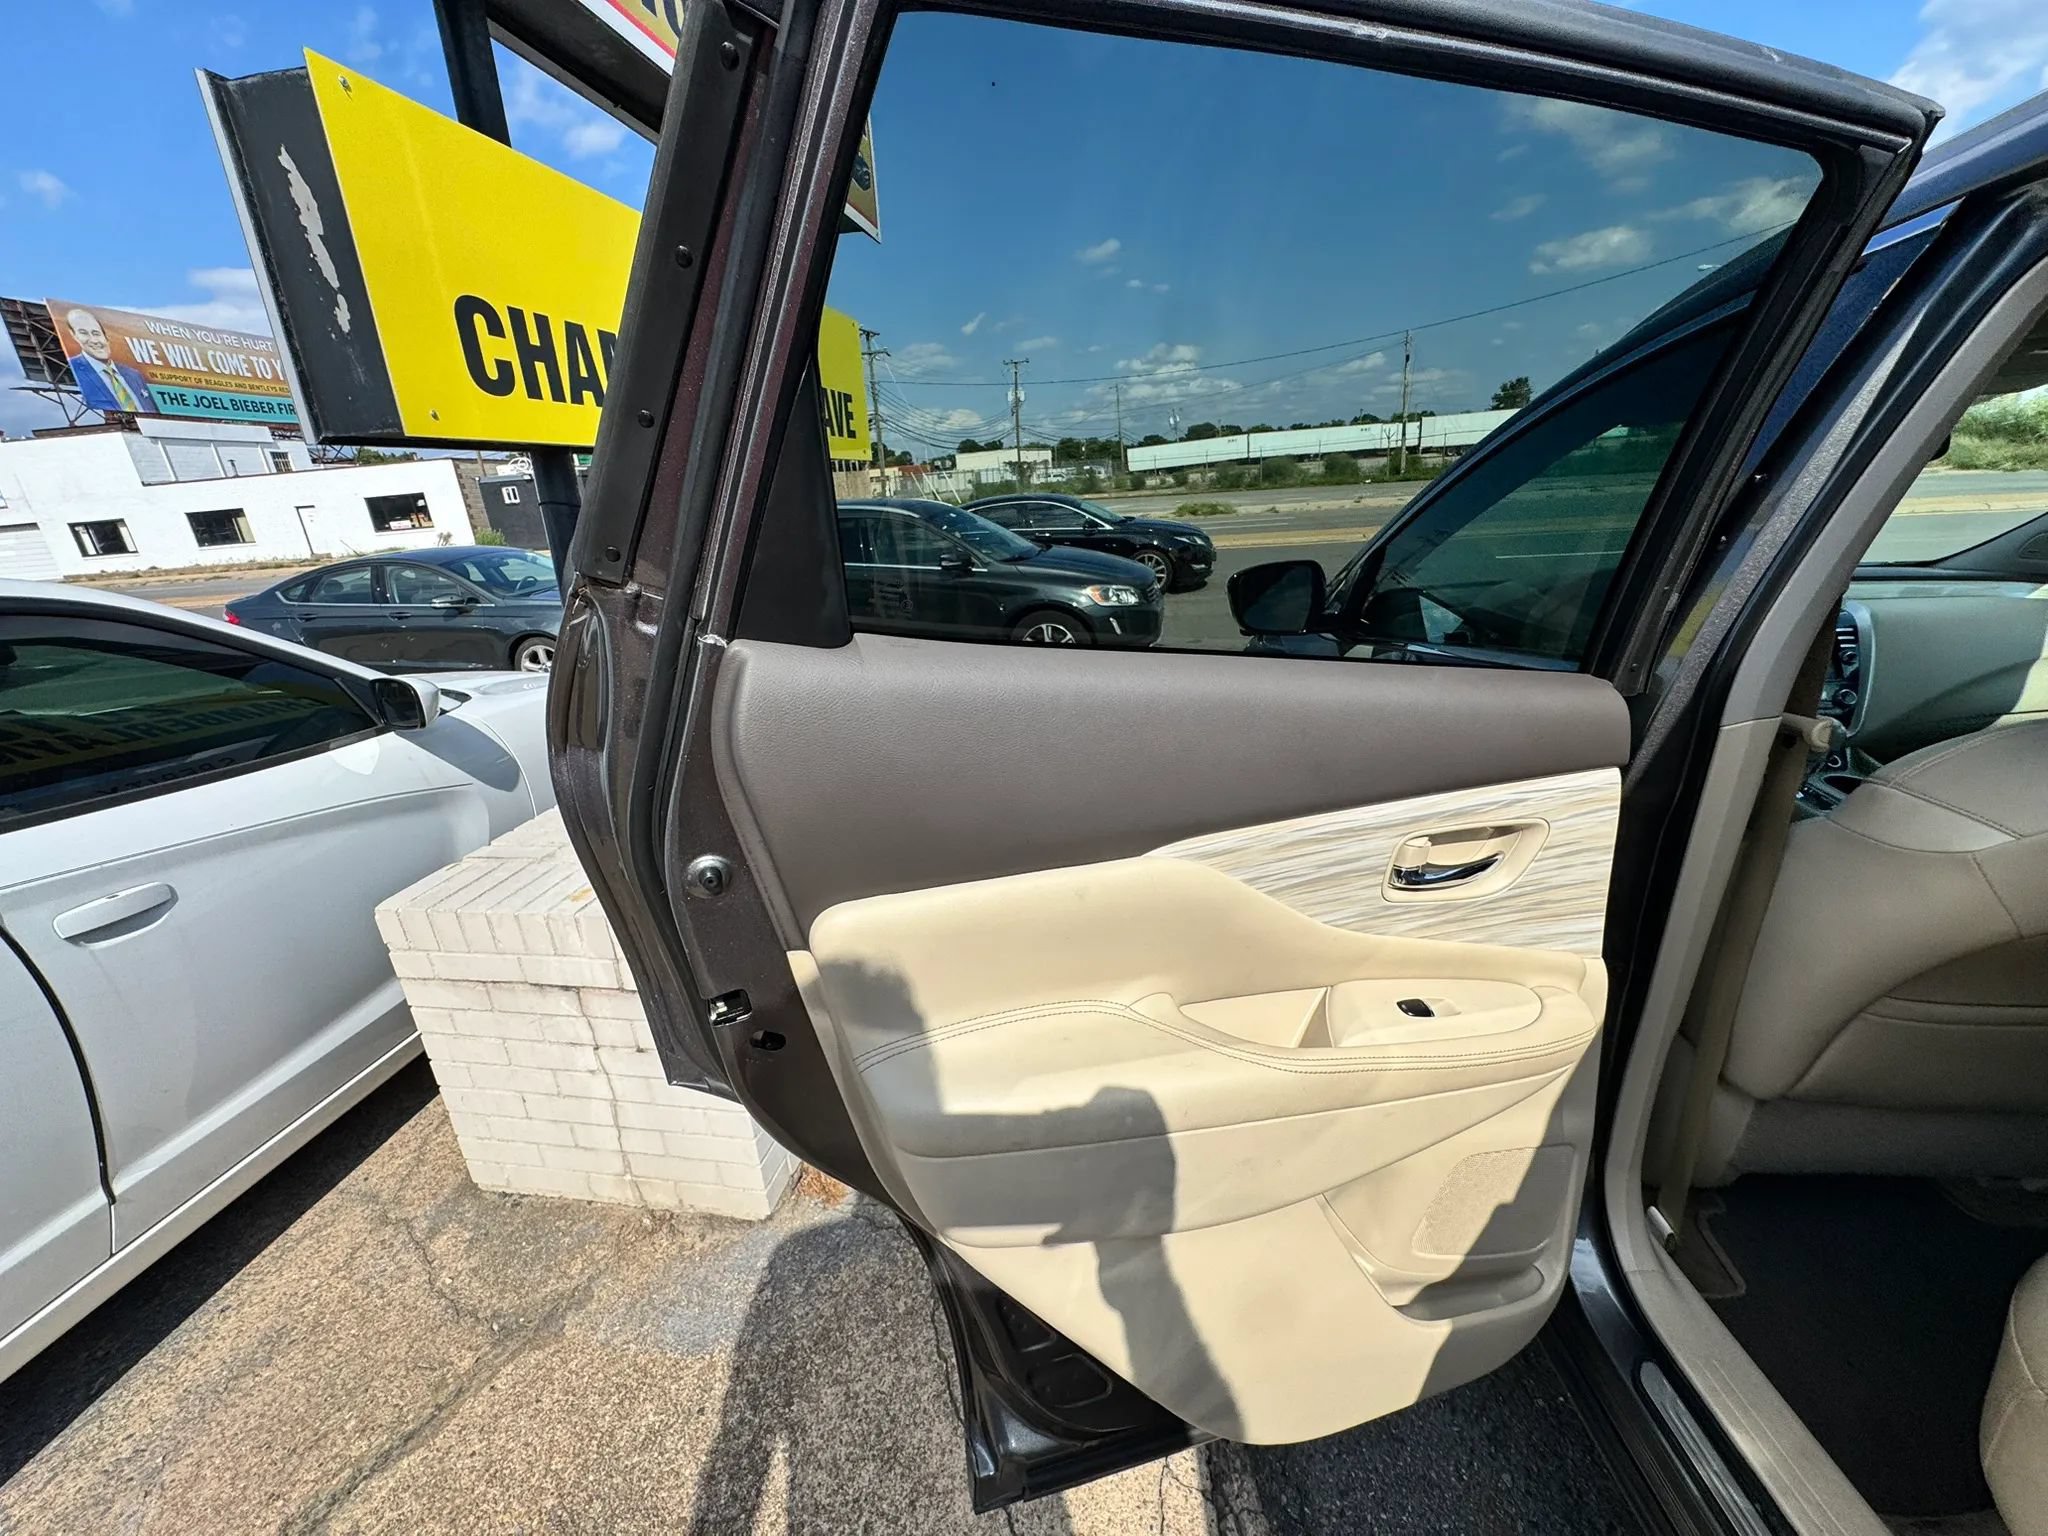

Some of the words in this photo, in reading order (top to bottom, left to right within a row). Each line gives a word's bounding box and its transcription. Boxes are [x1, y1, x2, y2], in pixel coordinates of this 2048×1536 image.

[144, 319, 191, 340] WHEN
[191, 327, 241, 348] YOU'RE
[241, 336, 273, 352] HURT
[124, 336, 164, 366] WE
[159, 341, 208, 372] WILL
[207, 349, 253, 378] COME
[249, 356, 273, 380] TO
[149, 371, 159, 379] IN
[159, 372, 193, 382] SUPPORT
[193, 377, 203, 385] OF
[203, 378, 234, 388] BEAGLES
[234, 381, 248, 389] AND
[247, 383, 278, 393] BENTLEYS
[156, 390, 190, 407] THE
[193, 394, 230, 411] JOEL
[229, 398, 277, 415] BIEBER
[276, 402, 297, 416] FIR
